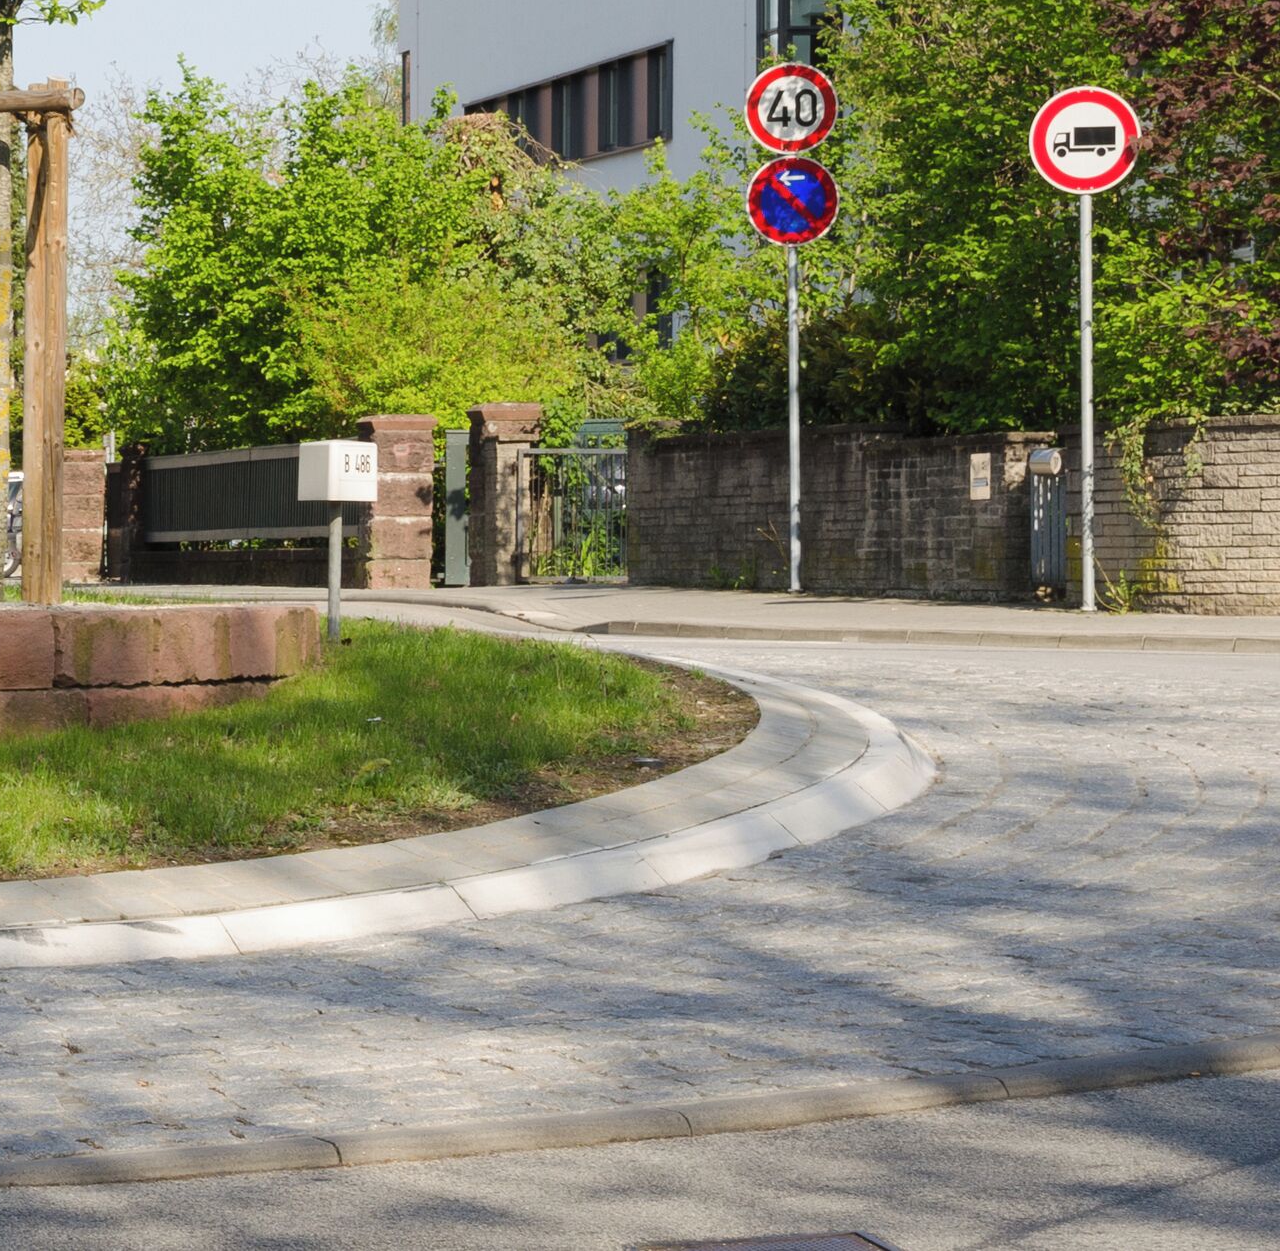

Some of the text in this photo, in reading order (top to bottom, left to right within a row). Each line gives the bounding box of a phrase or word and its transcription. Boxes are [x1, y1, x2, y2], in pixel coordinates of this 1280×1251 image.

[766, 88, 818, 128] 40
[344, 453, 371, 473] B 486
